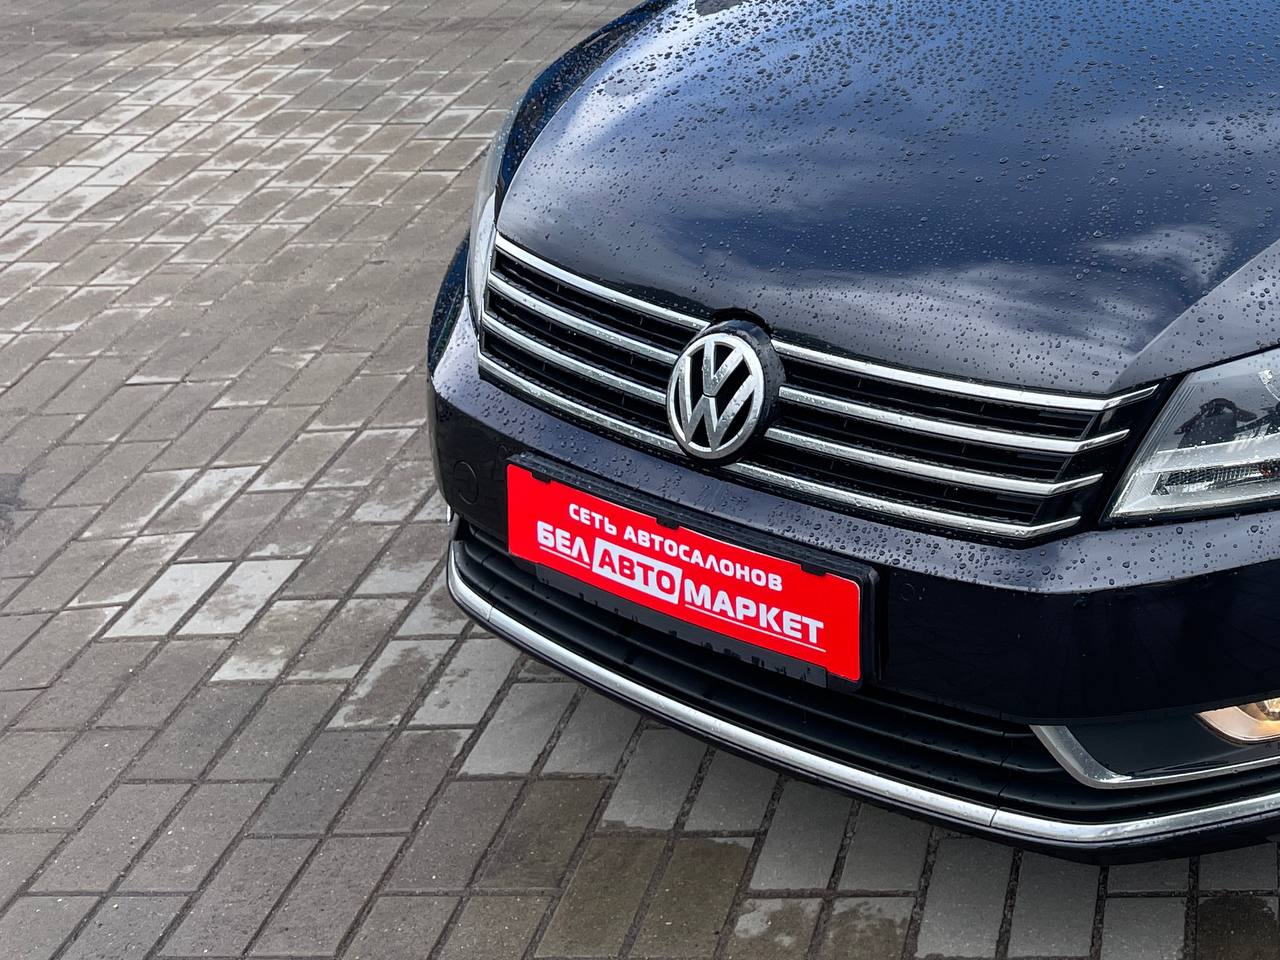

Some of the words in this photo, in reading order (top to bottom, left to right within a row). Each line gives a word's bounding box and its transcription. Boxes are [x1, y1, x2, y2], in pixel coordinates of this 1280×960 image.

[536, 520, 590, 564] БЕЛ
[597, 547, 677, 594] АВТО
[684, 578, 825, 645] МАРКЕТ
[568, 503, 618, 535] СЕТЬ
[623, 525, 783, 592] АВТОСАЛОНОВ
